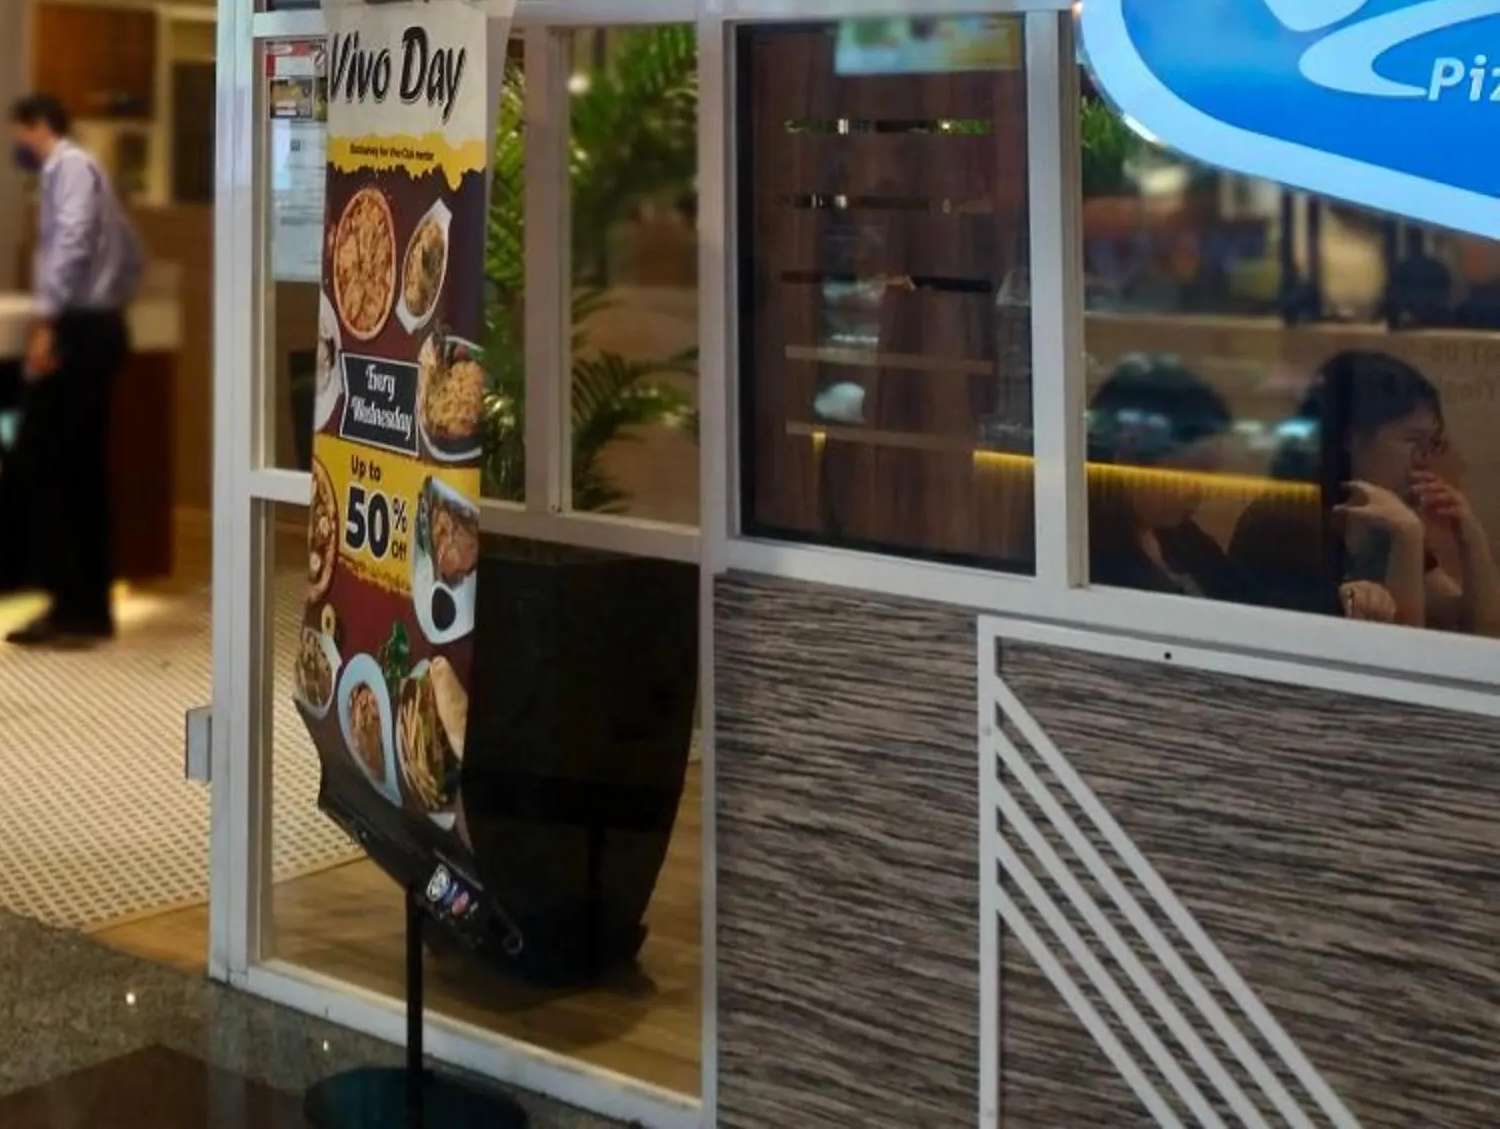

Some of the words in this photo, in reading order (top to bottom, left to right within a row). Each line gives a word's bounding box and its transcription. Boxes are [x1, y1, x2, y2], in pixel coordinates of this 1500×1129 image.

[330, 29, 391, 103] Vivo
[400, 25, 466, 125] Day
[365, 364, 396, 401] Every
[351, 395, 412, 440] Wednesday
[351, 455, 365, 479] Up
[369, 462, 381, 480] to
[391, 541, 407, 561] Off
